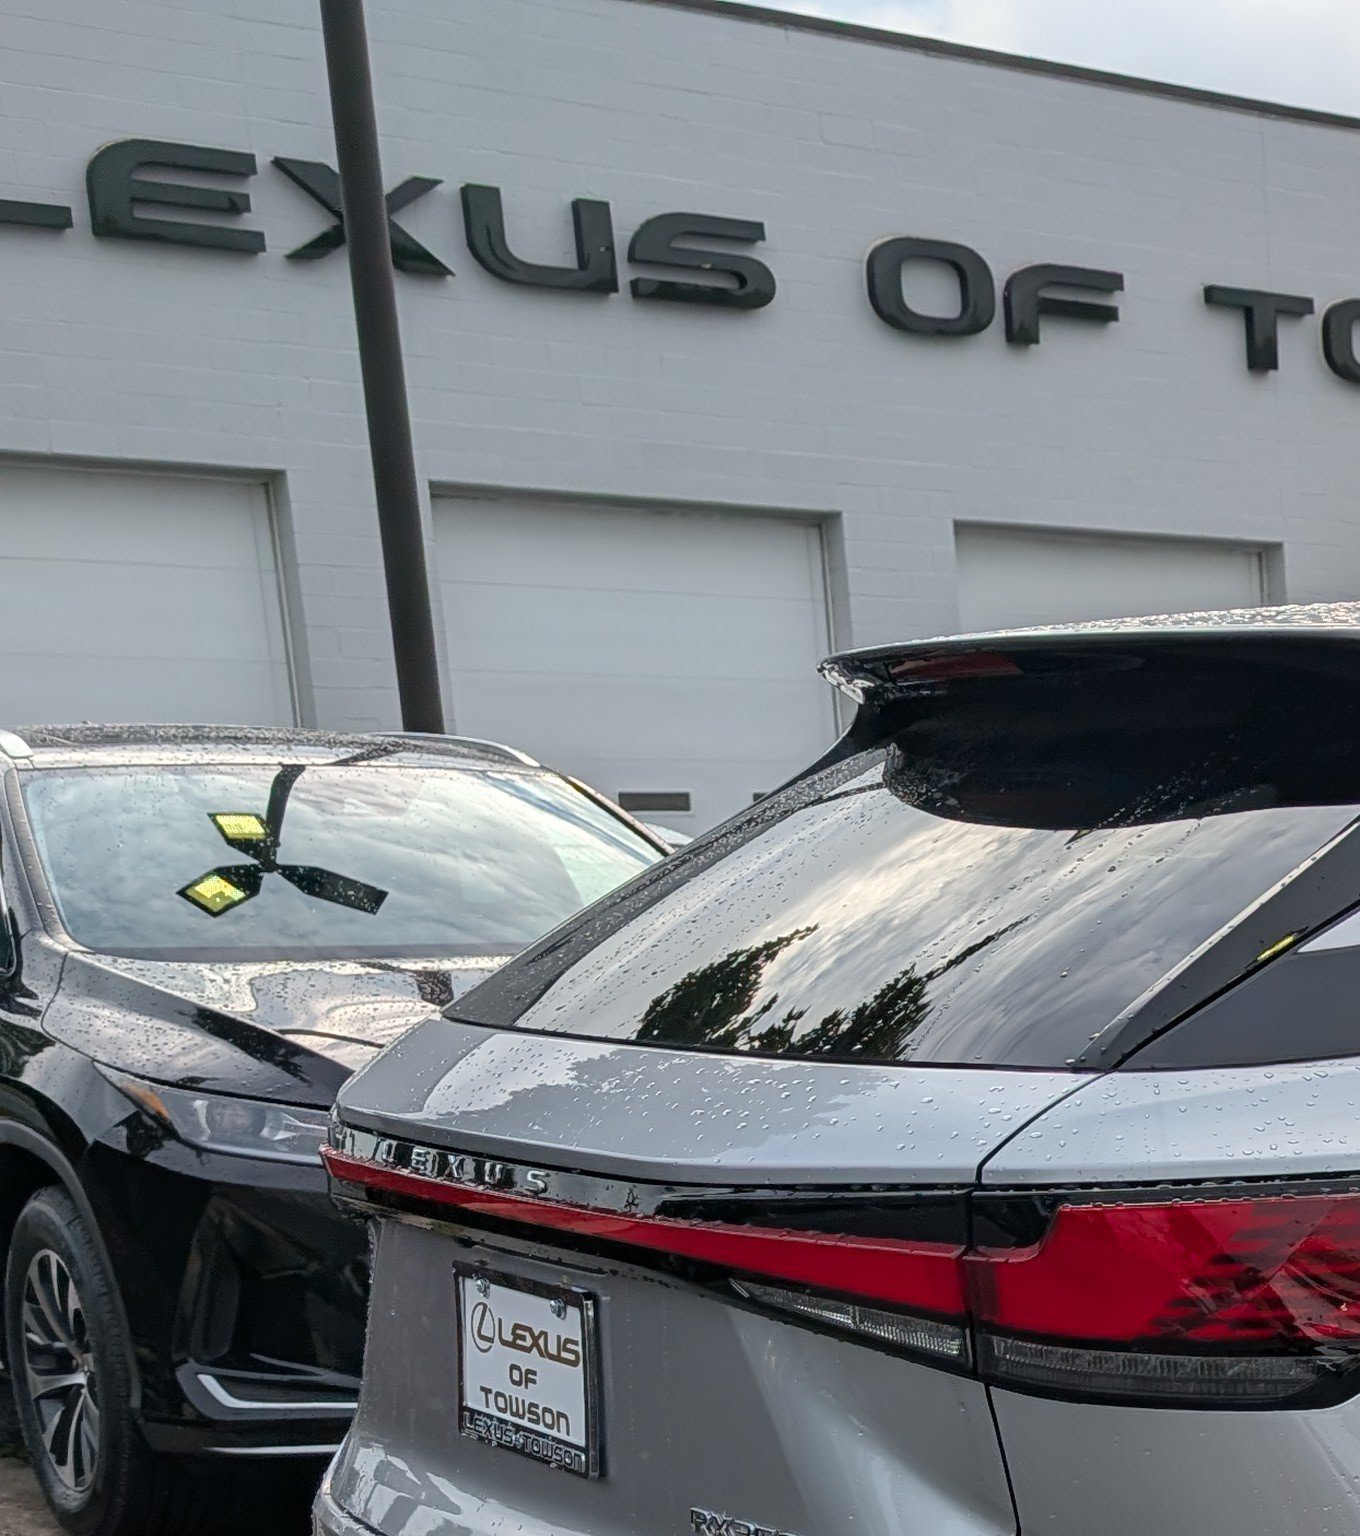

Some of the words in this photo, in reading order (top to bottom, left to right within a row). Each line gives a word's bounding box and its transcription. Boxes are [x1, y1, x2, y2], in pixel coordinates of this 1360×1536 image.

[865, 234, 1125, 346] OF
[498, 1316, 581, 1368] LEXUS
[508, 1362, 538, 1390] OF
[463, 1411, 515, 1447] LEXUS
[479, 1385, 571, 1437] TOWSON
